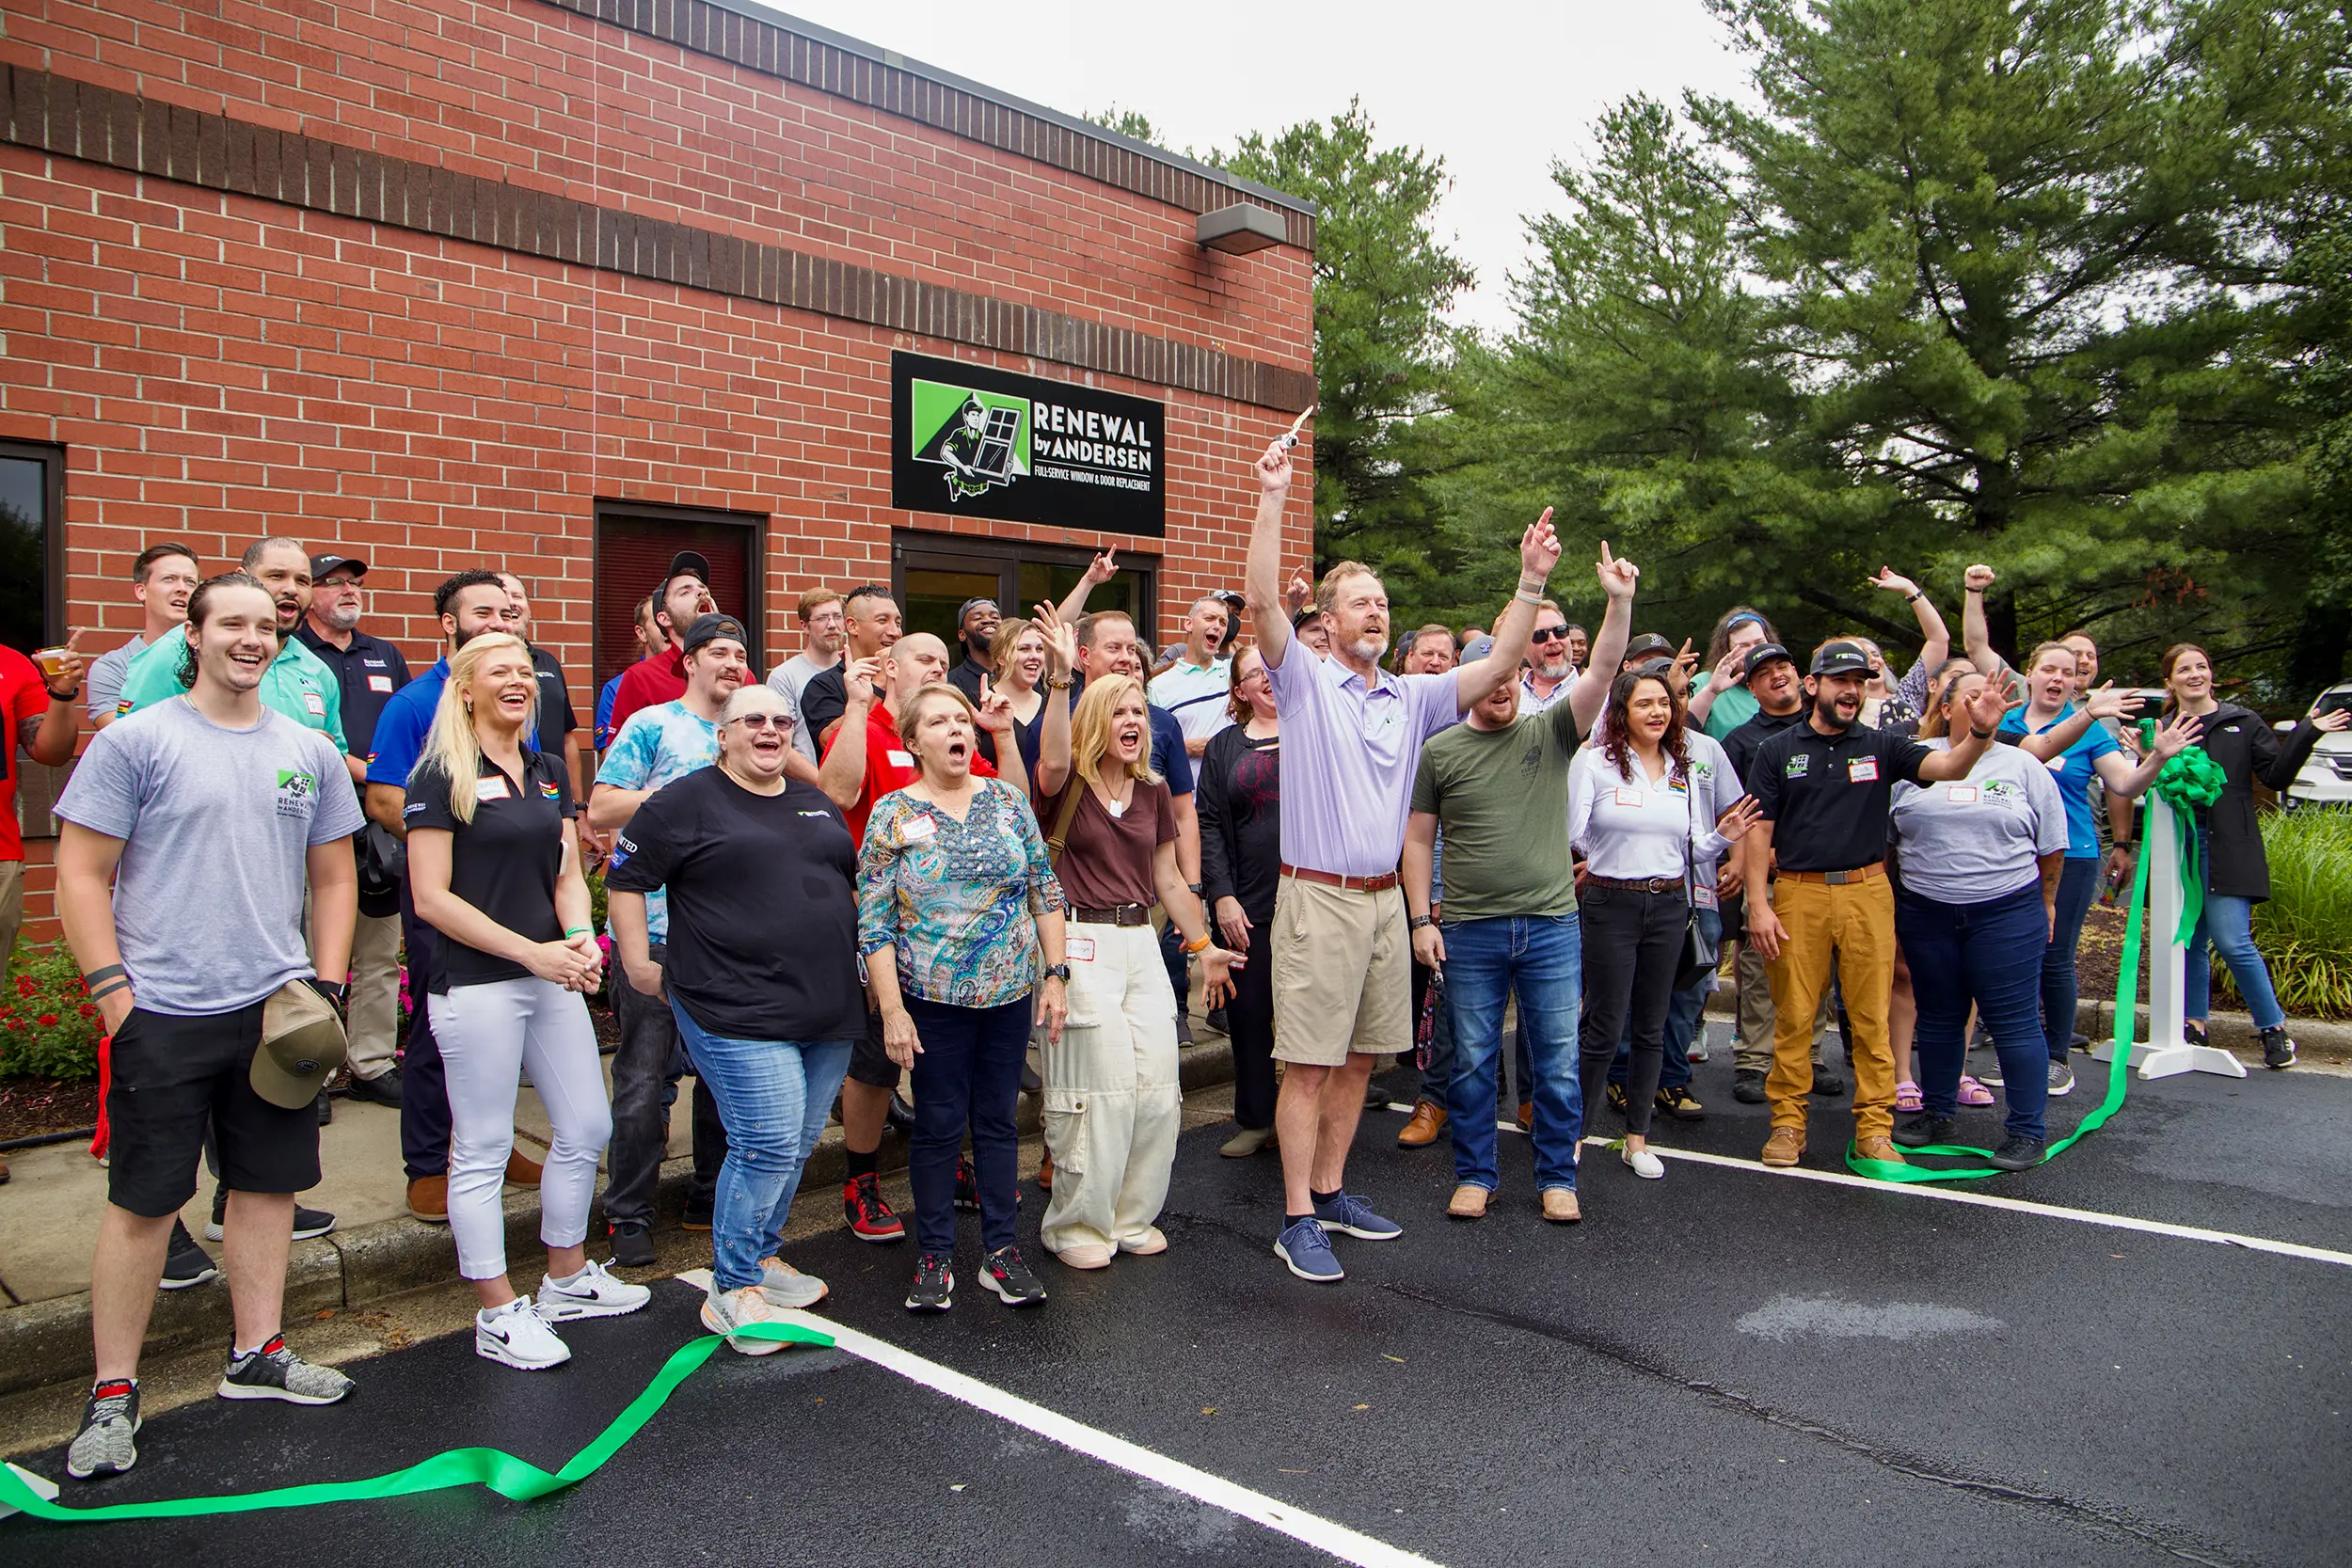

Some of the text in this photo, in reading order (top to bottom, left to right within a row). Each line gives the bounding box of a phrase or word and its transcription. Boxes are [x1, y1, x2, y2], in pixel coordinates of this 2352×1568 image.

[1034, 402, 1151, 448] RENEWAL
[1035, 433, 1152, 471] by ANDERSEN
[1035, 465, 1151, 492] FULL-SERVICE WINDOW & DOOR REPLACEMENT
